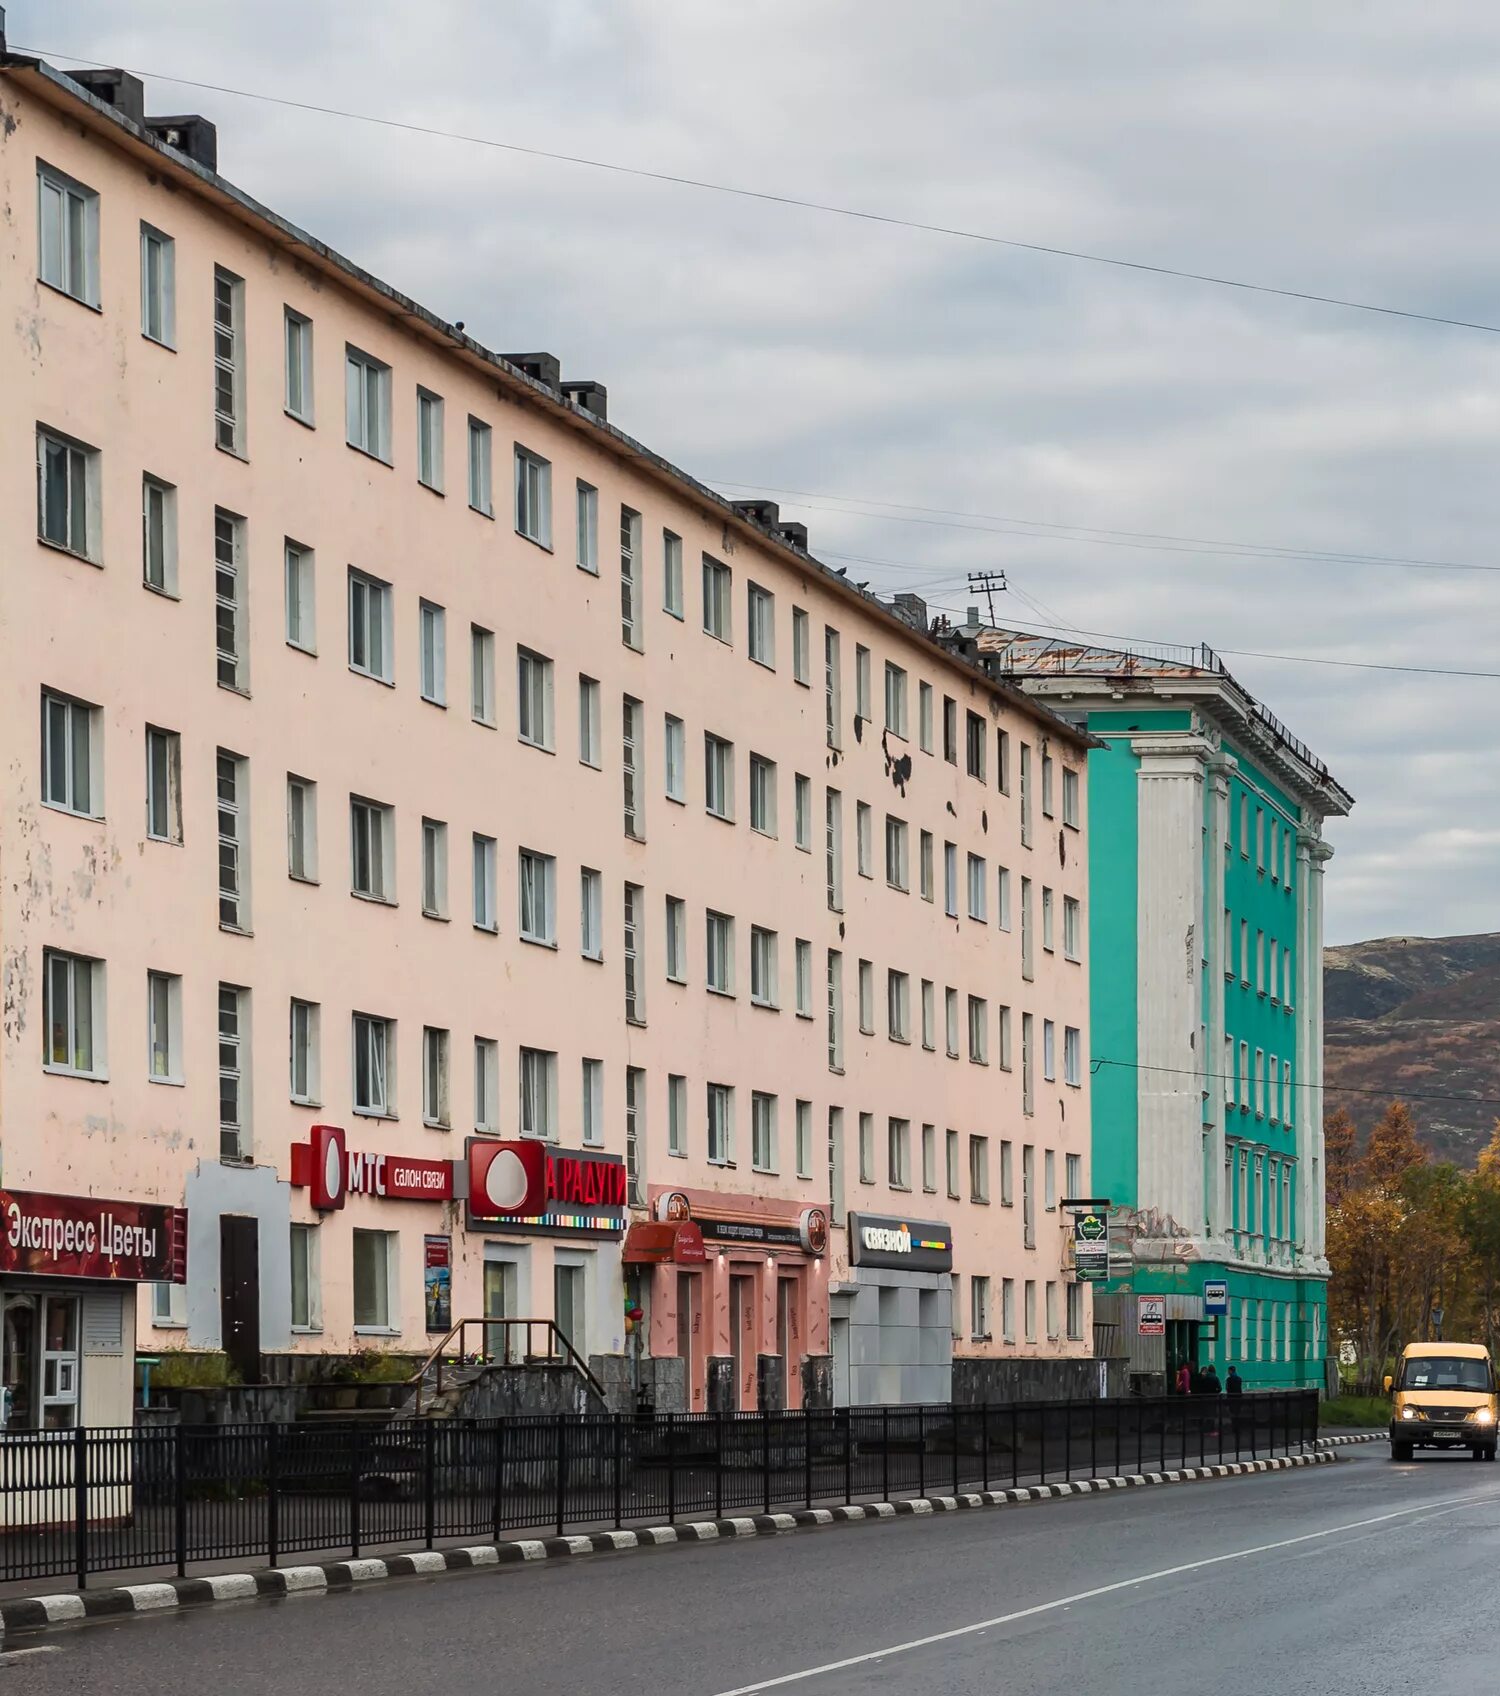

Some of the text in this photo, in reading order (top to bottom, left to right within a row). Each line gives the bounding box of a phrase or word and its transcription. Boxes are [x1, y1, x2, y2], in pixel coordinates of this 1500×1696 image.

[348, 1151, 386, 1196] МТС
[559, 1157, 626, 1206] РАДУГИ
[7, 1202, 157, 1264] Экспресс Цветы
